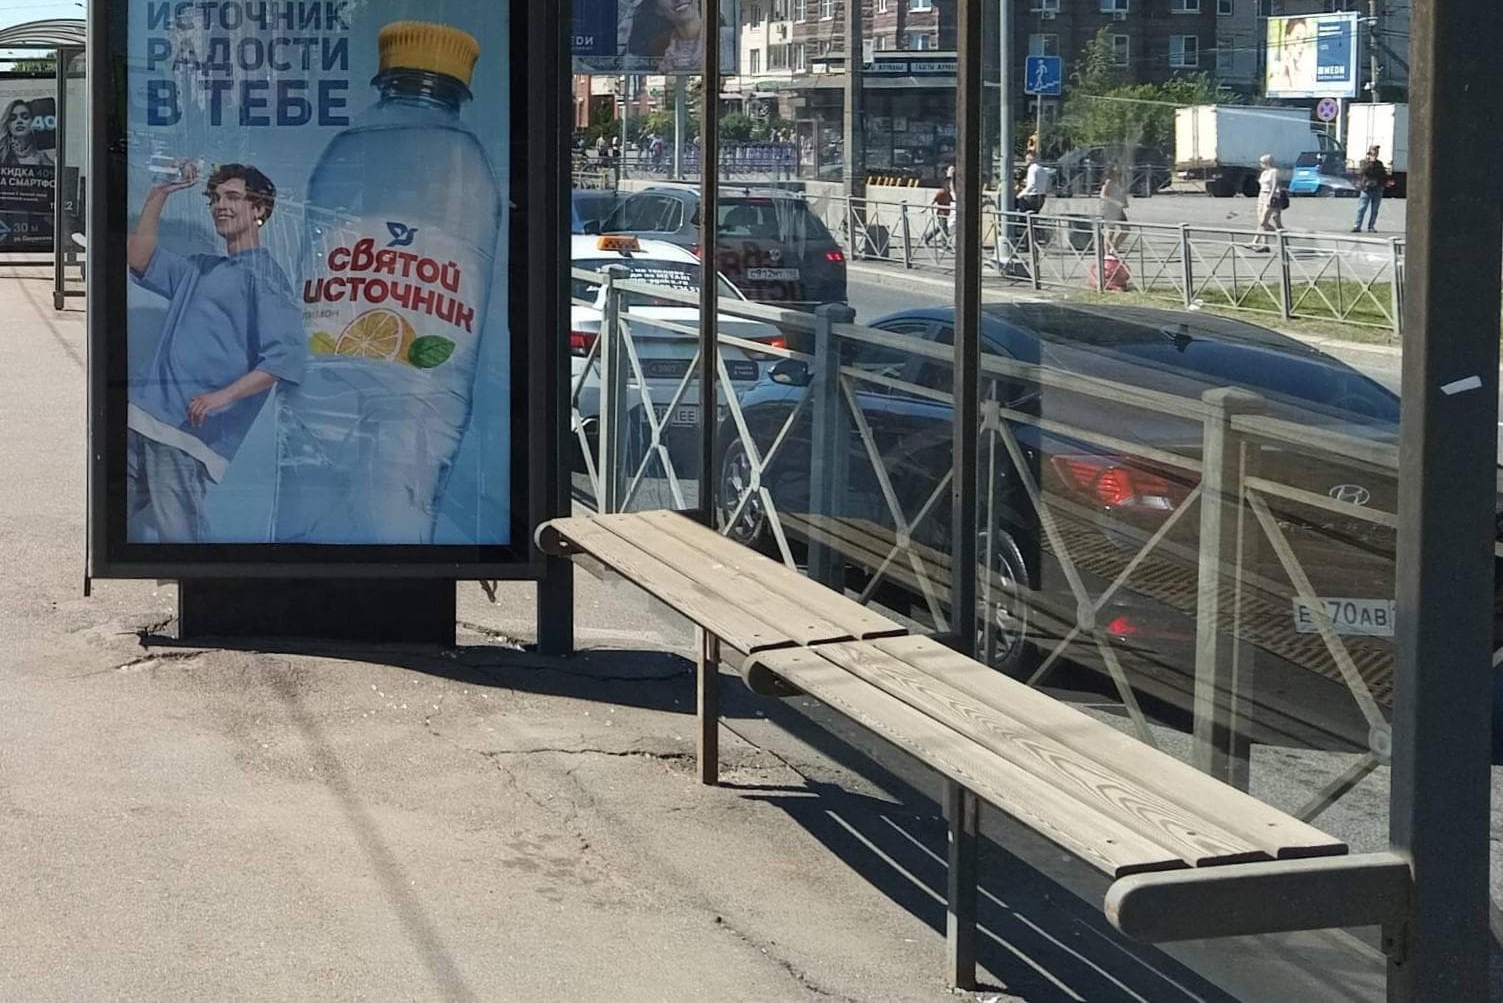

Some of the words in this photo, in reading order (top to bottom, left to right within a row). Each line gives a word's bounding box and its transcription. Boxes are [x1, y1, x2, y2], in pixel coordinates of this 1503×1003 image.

[146, 1, 350, 31] ИСТОЧНИК
[146, 37, 350, 77] РАДОСТИ
[146, 79, 182, 127] В
[205, 79, 350, 127] ТЕБЕ
[8, 178, 56, 188] СМАРТФО
[14, 223, 28, 233] 30
[1299, 601, 1387, 626] Е70АВ
